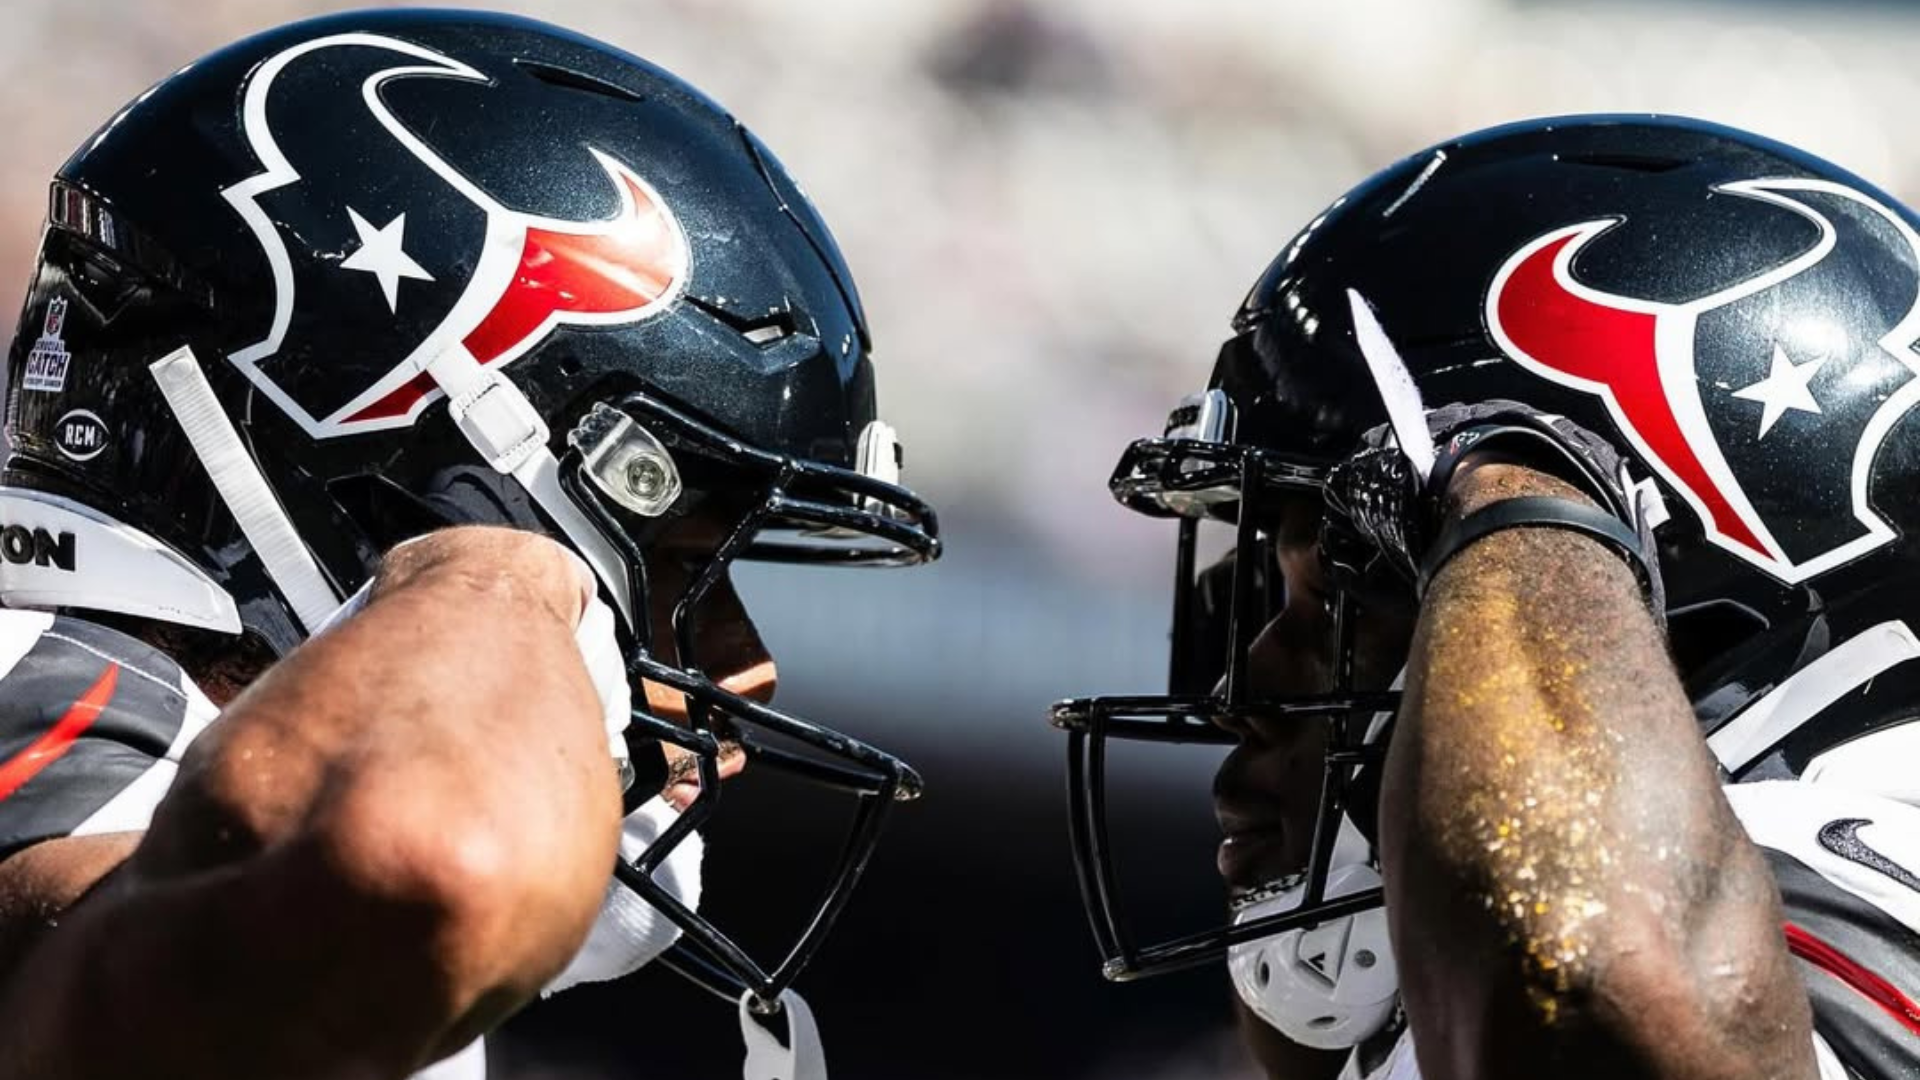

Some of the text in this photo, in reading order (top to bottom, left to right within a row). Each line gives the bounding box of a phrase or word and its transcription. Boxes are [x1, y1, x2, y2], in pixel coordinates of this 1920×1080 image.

[28, 352, 69, 377] CATCH
[65, 424, 95, 447] RCM
[0, 524, 75, 572] ON
